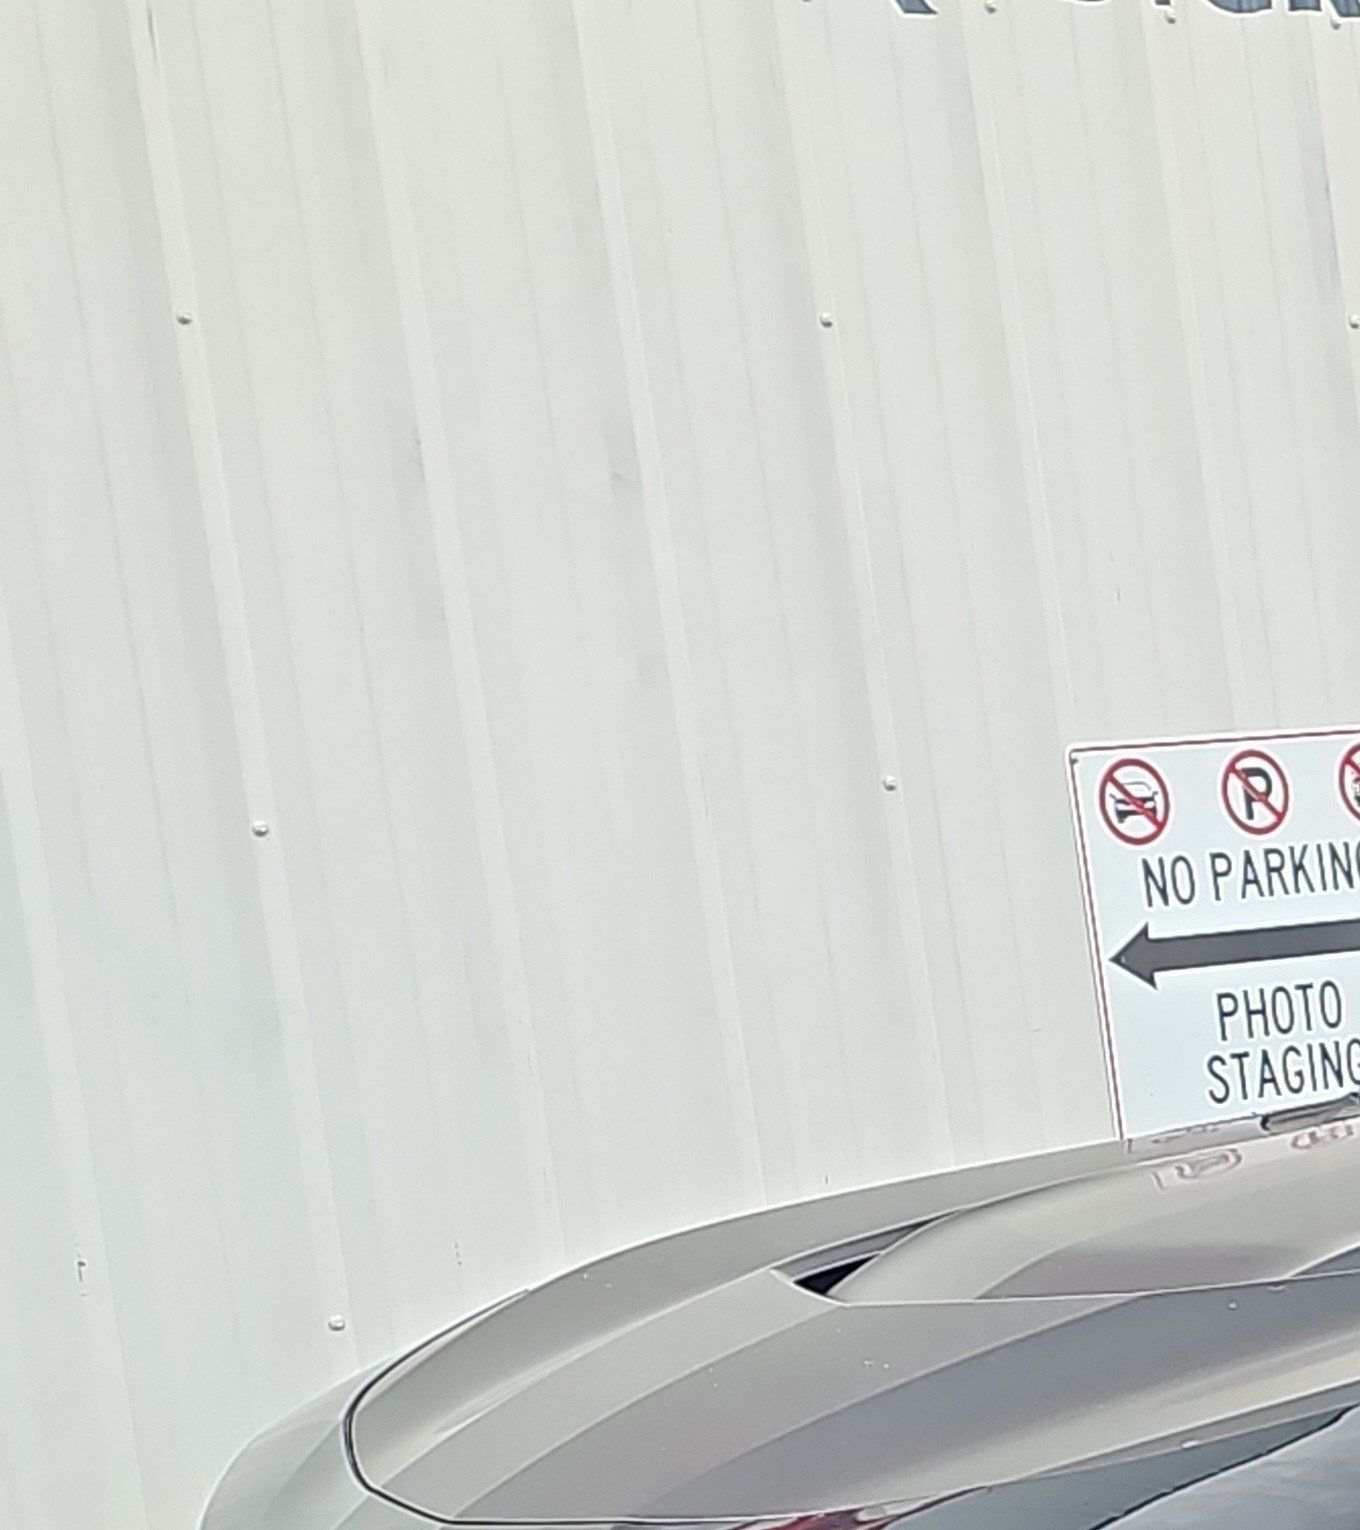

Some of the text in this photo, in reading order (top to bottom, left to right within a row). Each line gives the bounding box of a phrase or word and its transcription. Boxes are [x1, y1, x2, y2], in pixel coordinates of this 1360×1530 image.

[1239, 767, 1273, 821] P
[1142, 855, 1196, 908] NO
[1215, 980, 1342, 1042] PHOTO
